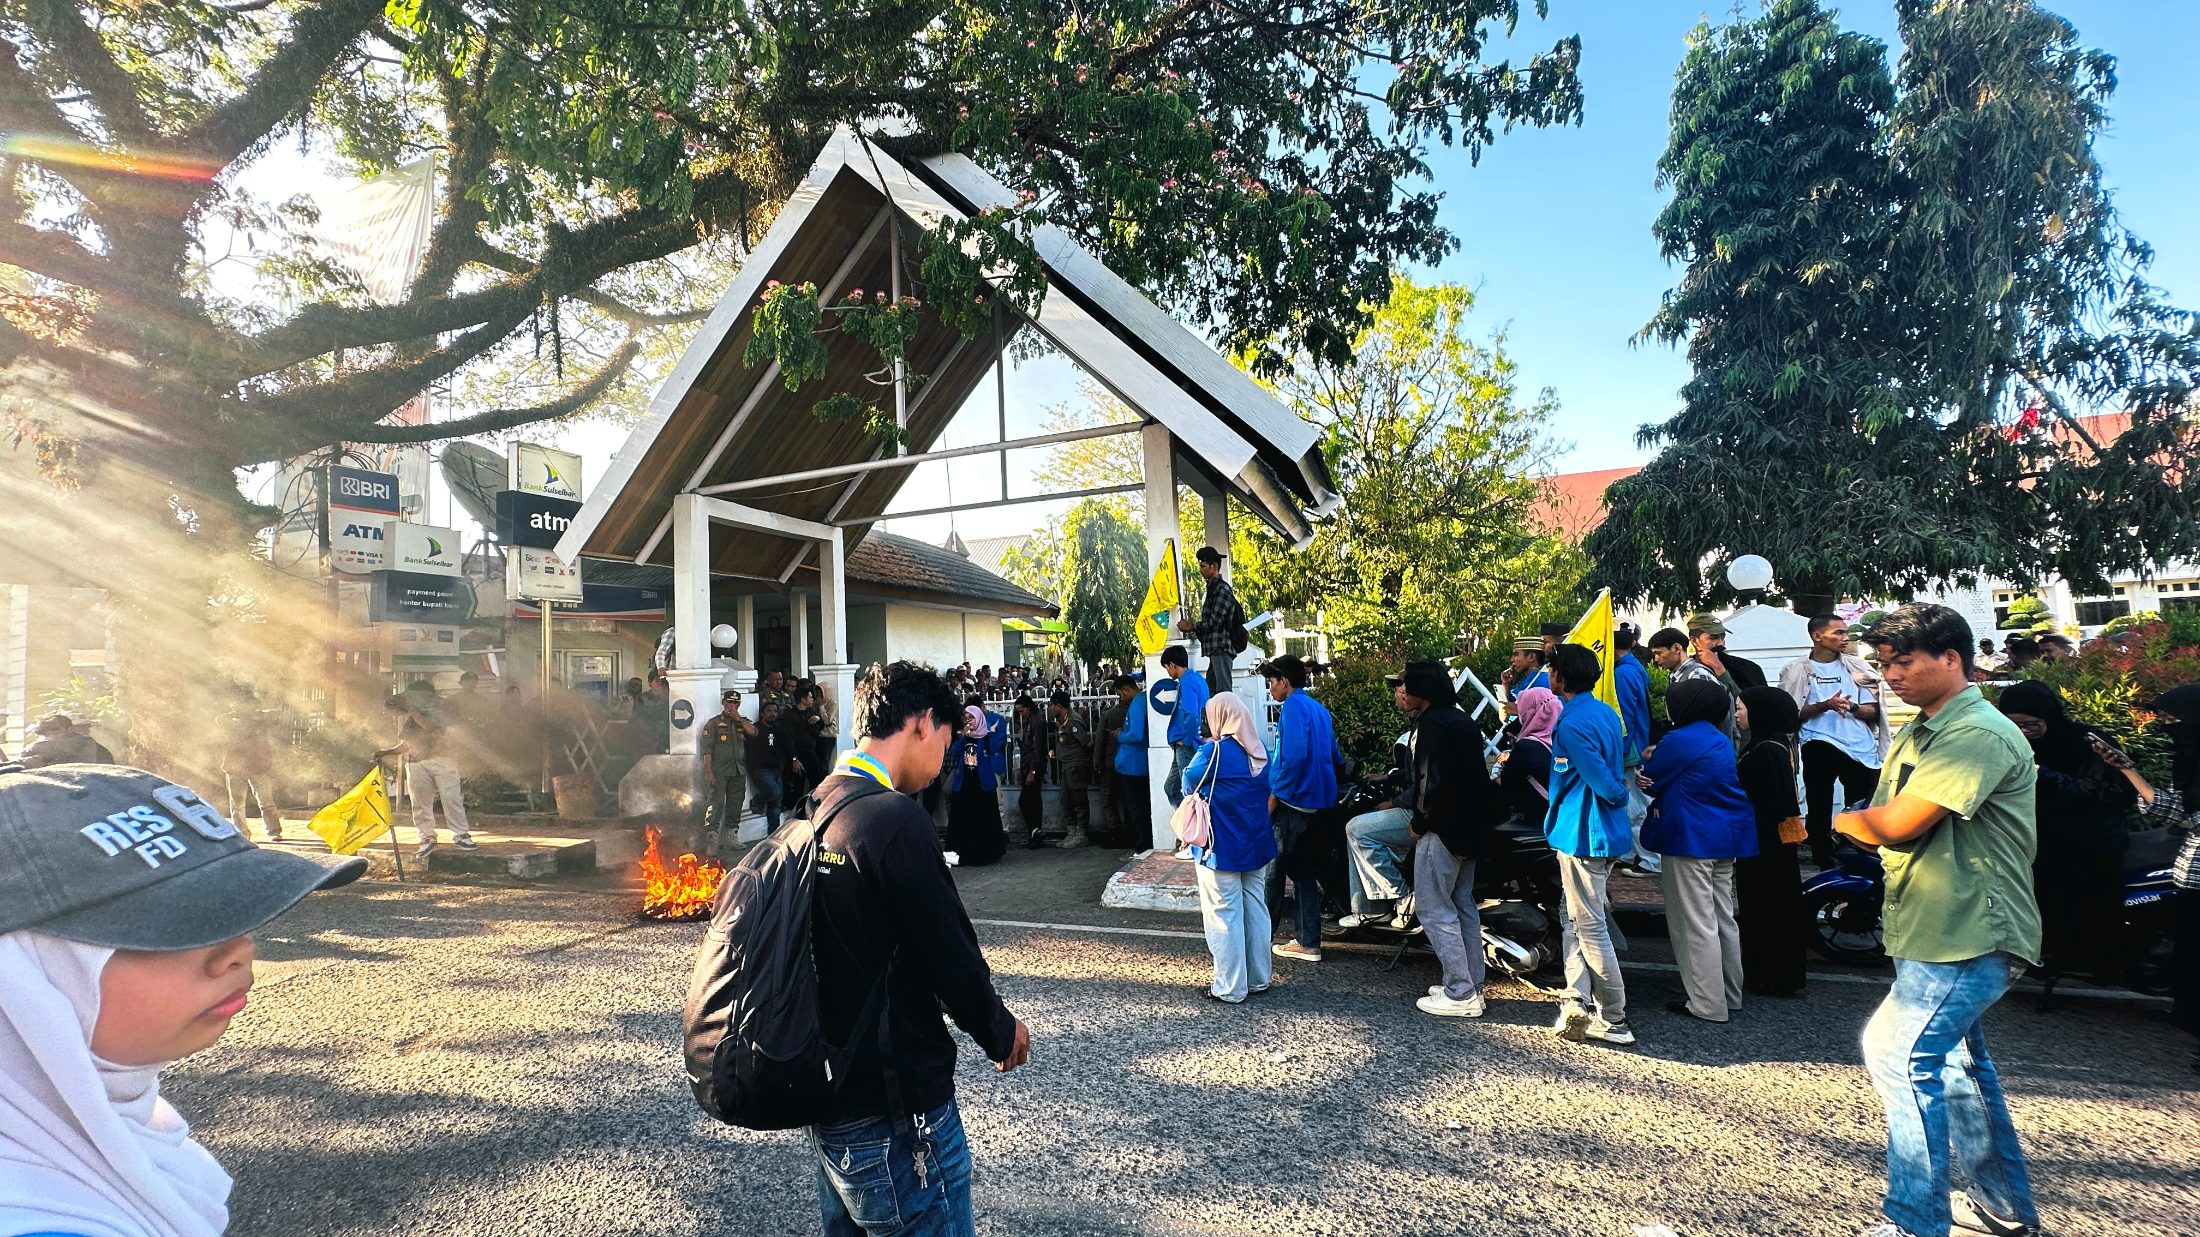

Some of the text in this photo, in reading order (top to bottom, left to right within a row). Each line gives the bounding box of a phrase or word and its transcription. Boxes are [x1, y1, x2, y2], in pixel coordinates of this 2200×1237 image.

[360, 481, 390, 500] BRI
[530, 511, 571, 532] atm
[80, 805, 174, 857] RES
[134, 835, 187, 868] FD
